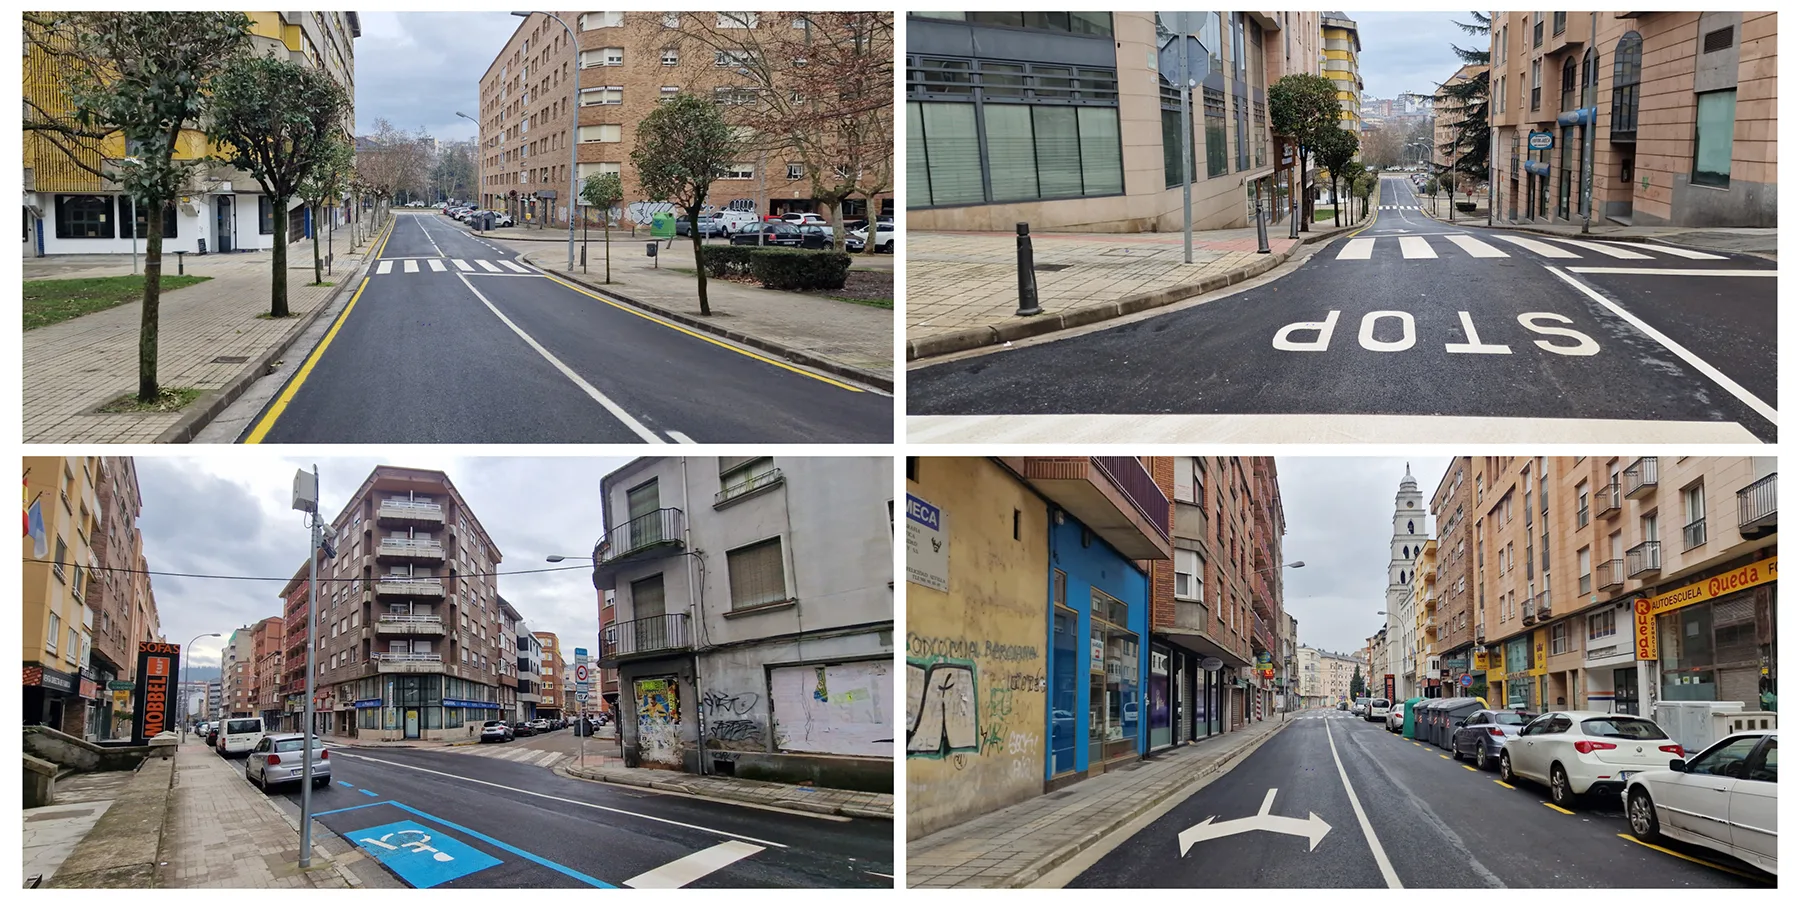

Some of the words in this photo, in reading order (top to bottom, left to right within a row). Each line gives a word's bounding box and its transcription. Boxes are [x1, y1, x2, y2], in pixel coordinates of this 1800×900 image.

[1272, 310, 1600, 356] STOP
[1651, 586, 1702, 610] AUTOESCUELA
[1708, 567, 1759, 597] Rueda
[139, 641, 180, 654] SOFAS
[1635, 599, 1651, 658] Rueda
[144, 676, 166, 737] MOBBEL
